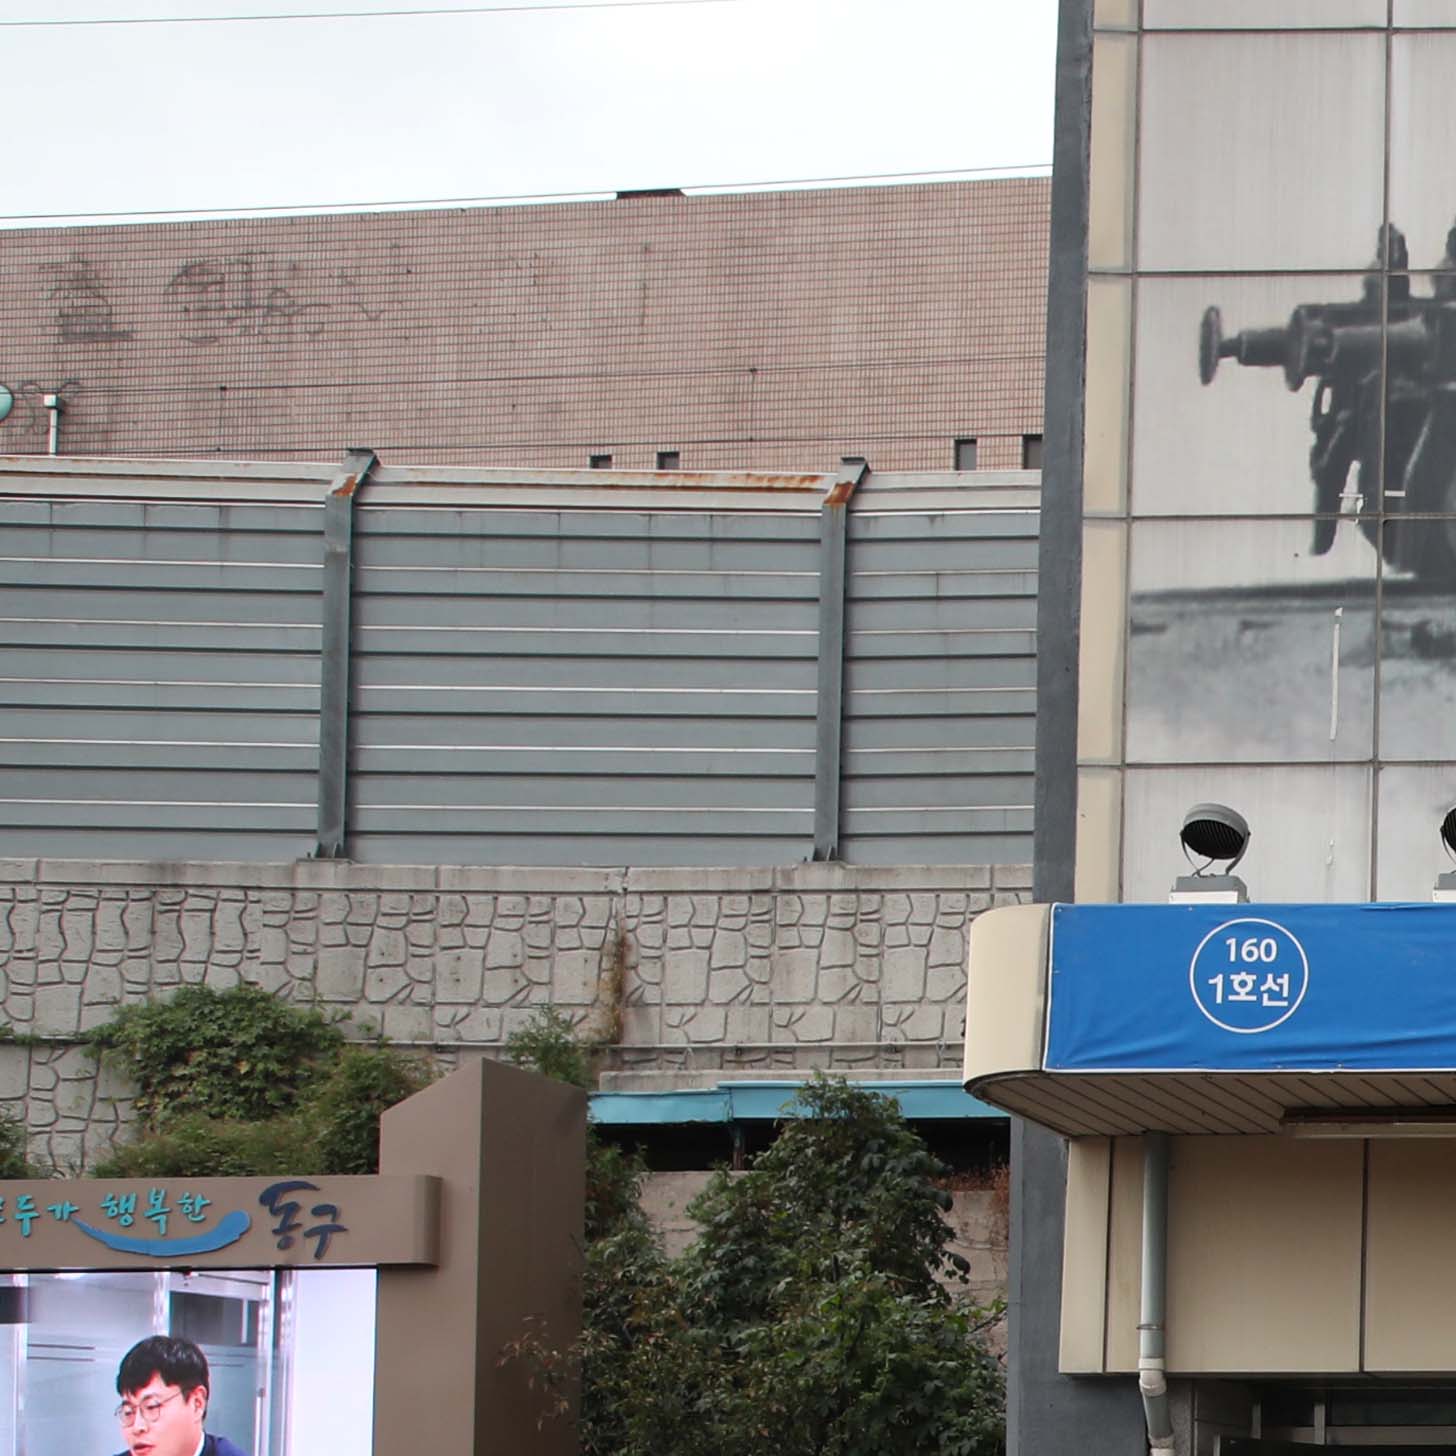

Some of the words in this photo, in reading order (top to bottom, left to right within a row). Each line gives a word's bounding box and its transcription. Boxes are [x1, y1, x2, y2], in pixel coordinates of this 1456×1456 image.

[1224, 937, 1278, 962] 160
[1207, 971, 1290, 1009] 1호선
[0, 1194, 79, 1237] 두가
[101, 1188, 211, 1236] 행복한
[259, 1180, 349, 1260] 동구
